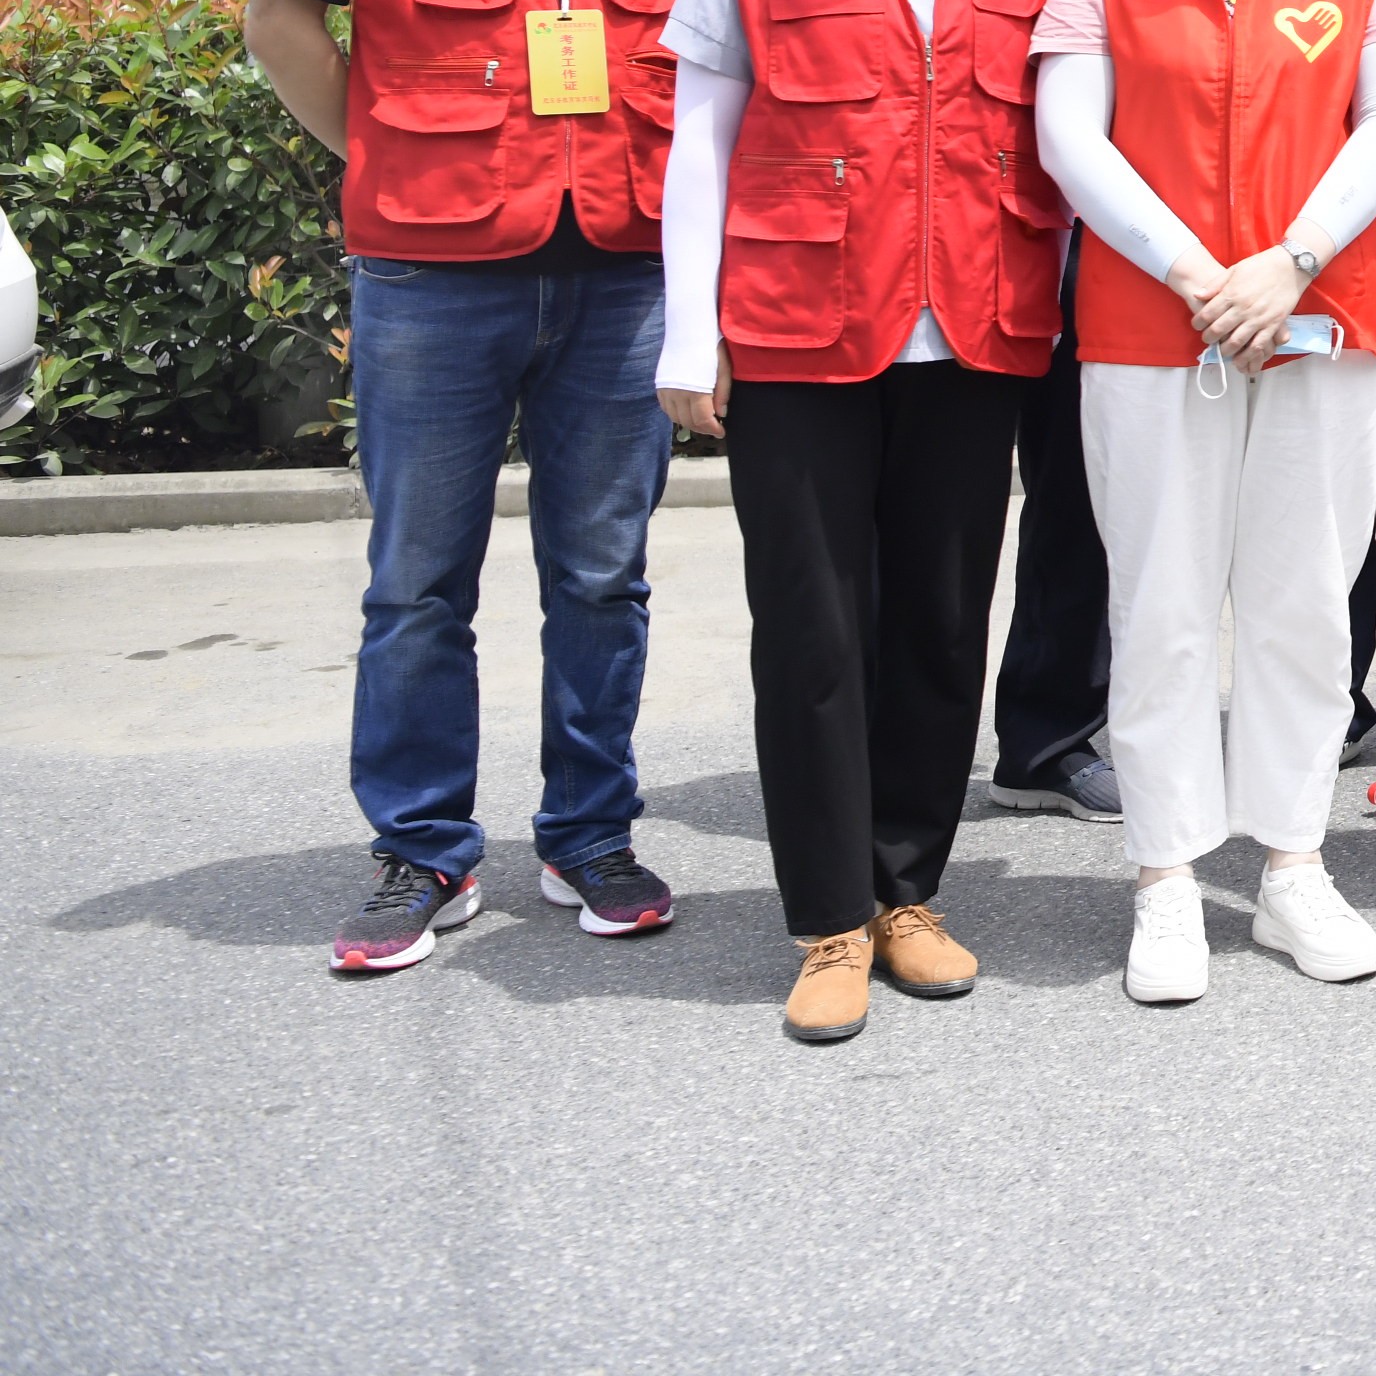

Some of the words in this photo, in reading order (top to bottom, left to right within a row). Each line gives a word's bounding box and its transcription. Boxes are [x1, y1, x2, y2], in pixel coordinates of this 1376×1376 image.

[560, 34, 578, 91] 考务工作证
